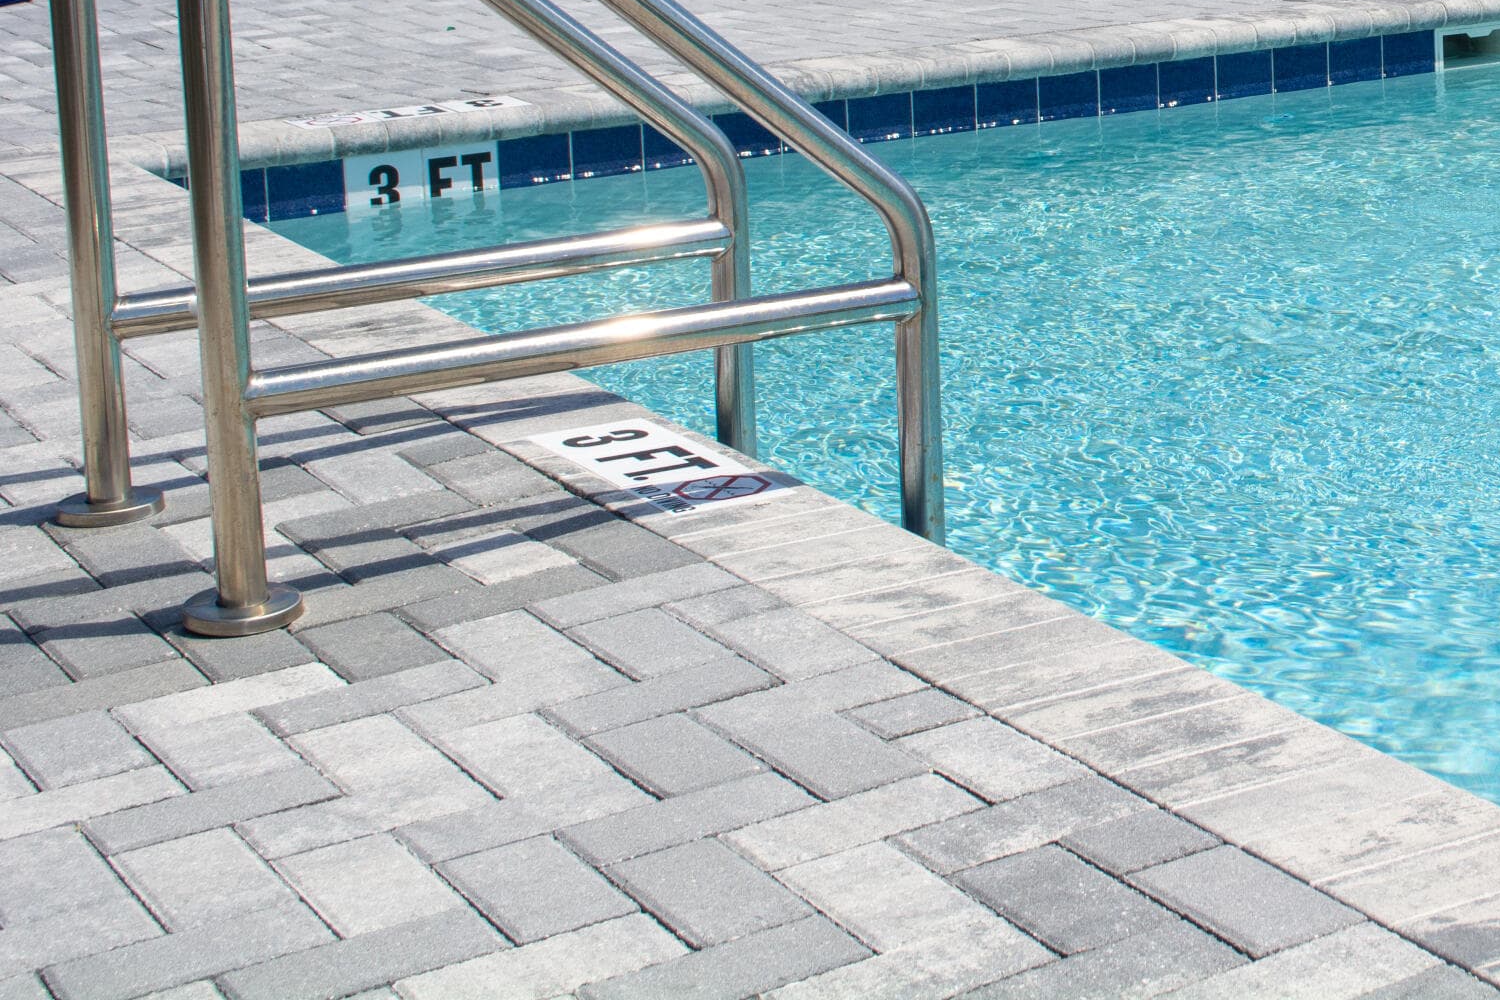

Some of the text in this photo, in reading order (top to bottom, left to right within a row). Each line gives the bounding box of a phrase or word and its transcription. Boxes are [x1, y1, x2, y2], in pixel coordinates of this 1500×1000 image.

[369, 152, 492, 206] 3 FT
[562, 429, 720, 481] 3 FT.
